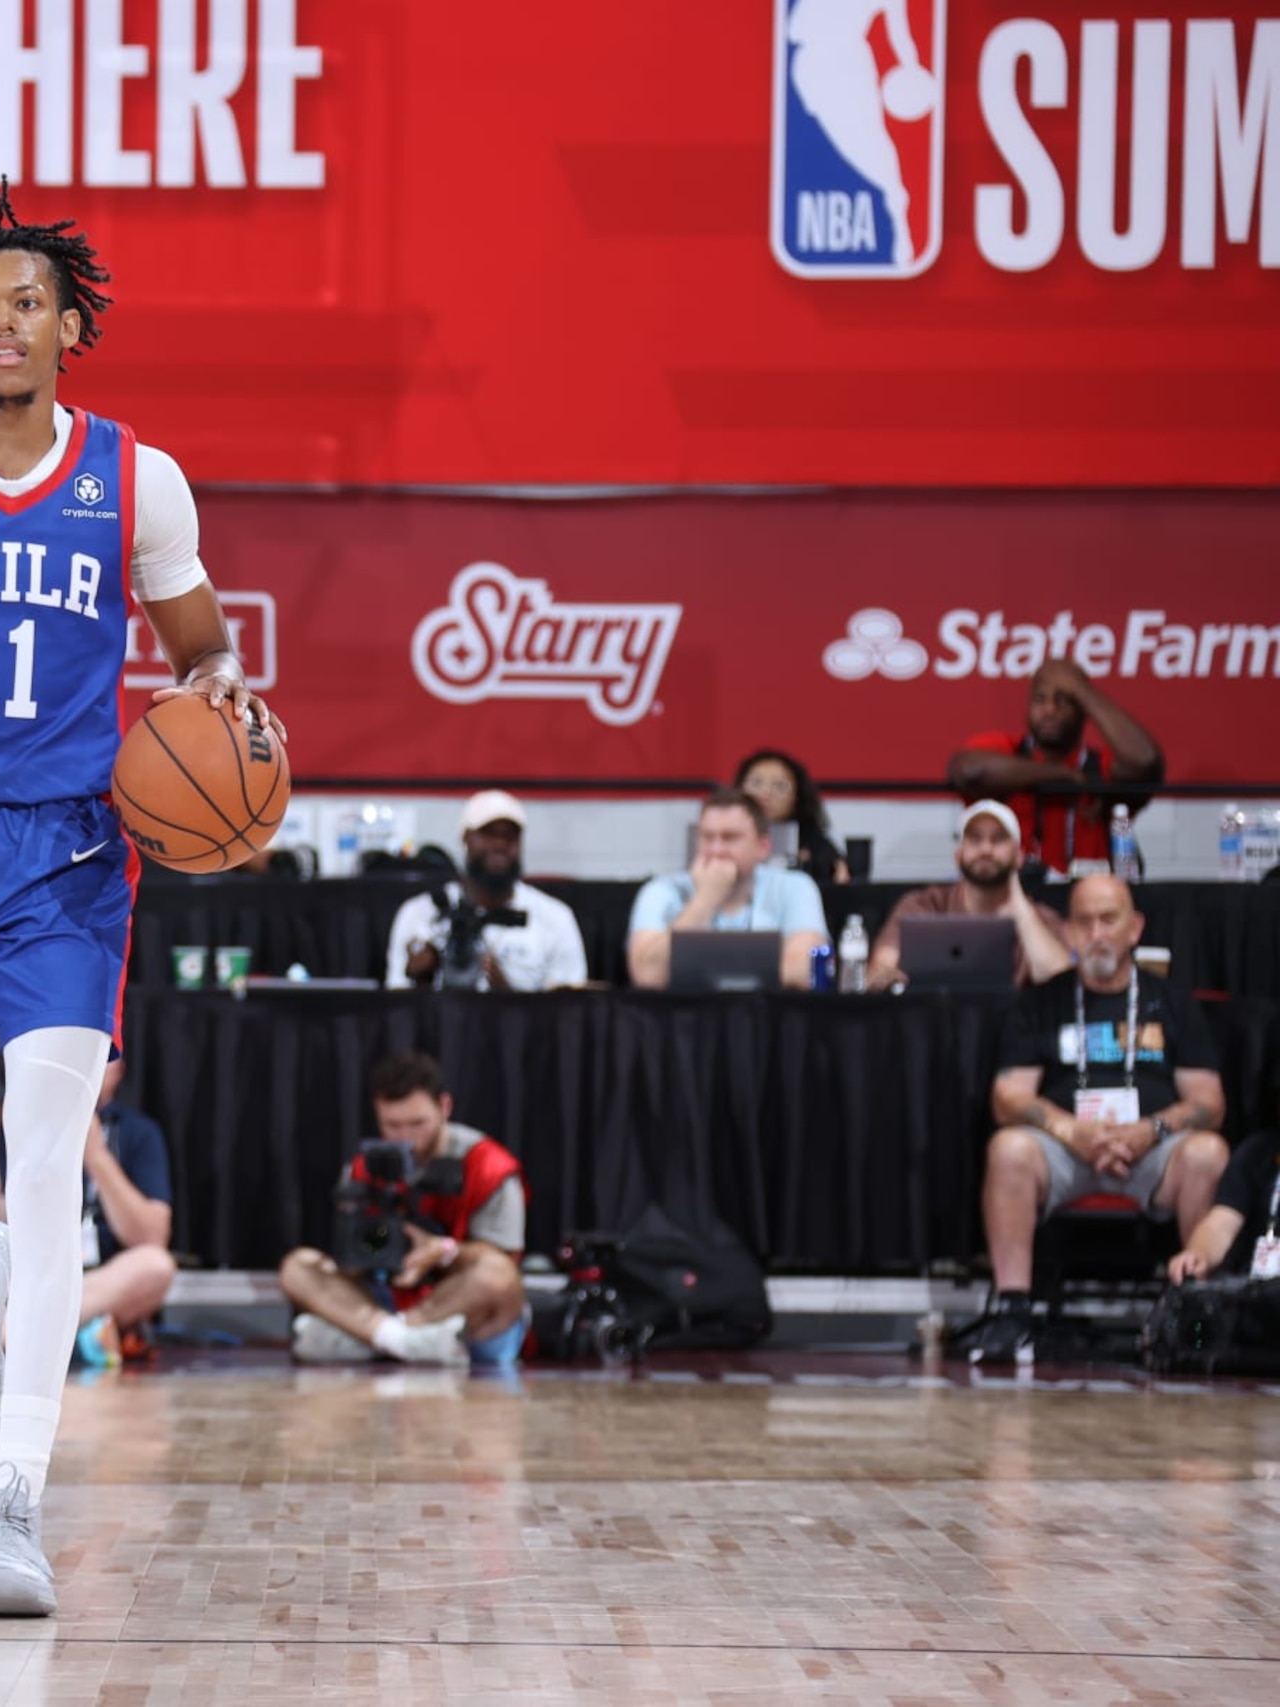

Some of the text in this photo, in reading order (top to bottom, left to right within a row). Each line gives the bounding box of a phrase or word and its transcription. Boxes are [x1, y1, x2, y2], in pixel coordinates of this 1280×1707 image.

[974, 18, 1280, 272] SUM
[796, 191, 877, 253] NBA
[62, 508, 118, 520] crypto.com
[414, 565, 680, 722] Starry
